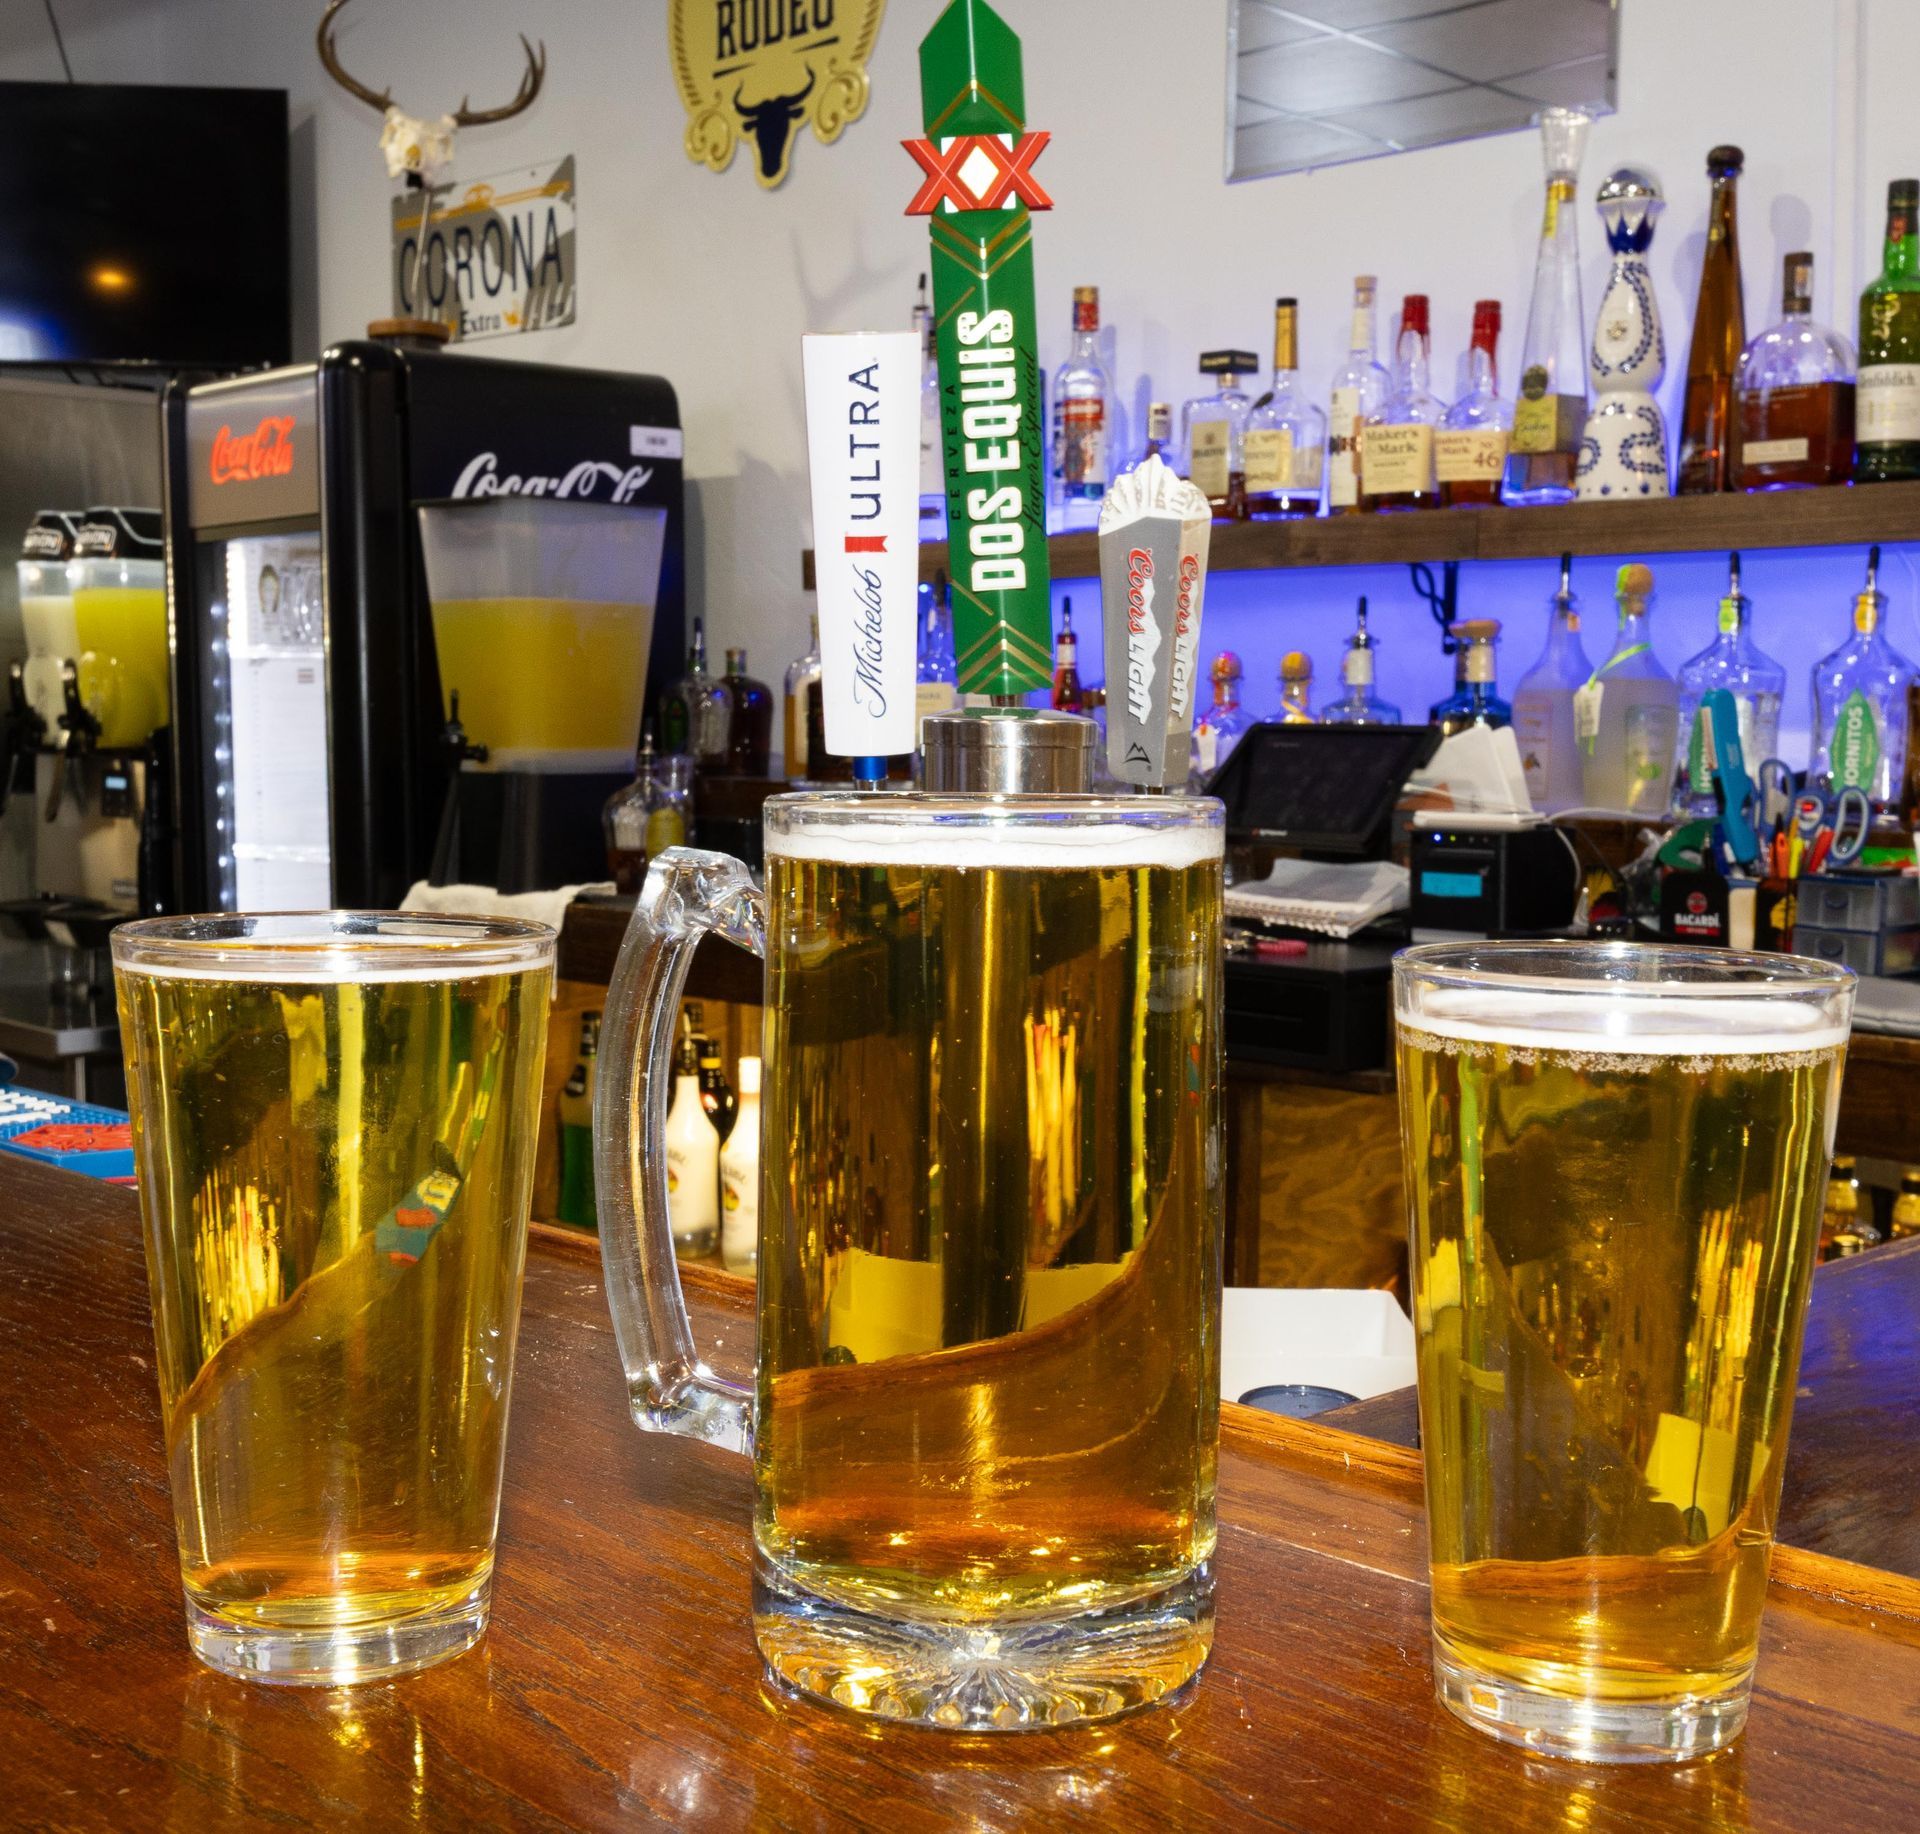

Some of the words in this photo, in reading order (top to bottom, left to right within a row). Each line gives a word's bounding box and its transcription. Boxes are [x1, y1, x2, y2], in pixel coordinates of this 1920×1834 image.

[401, 206, 562, 313] CORONA
[460, 311, 501, 335] Extra
[957, 309, 1022, 473] EQUIS
[848, 363, 882, 520] ULTRA
[945, 384, 961, 521] CERVEZA
[1473, 451, 1500, 468] 46
[967, 486, 1027, 592] DOS
[1128, 547, 1155, 635] Coors
[1176, 553, 1200, 636] Coors
[853, 564, 887, 718] Michelob
[1128, 634, 1147, 726] LIGHT
[1171, 636, 1189, 718] LIGHT
